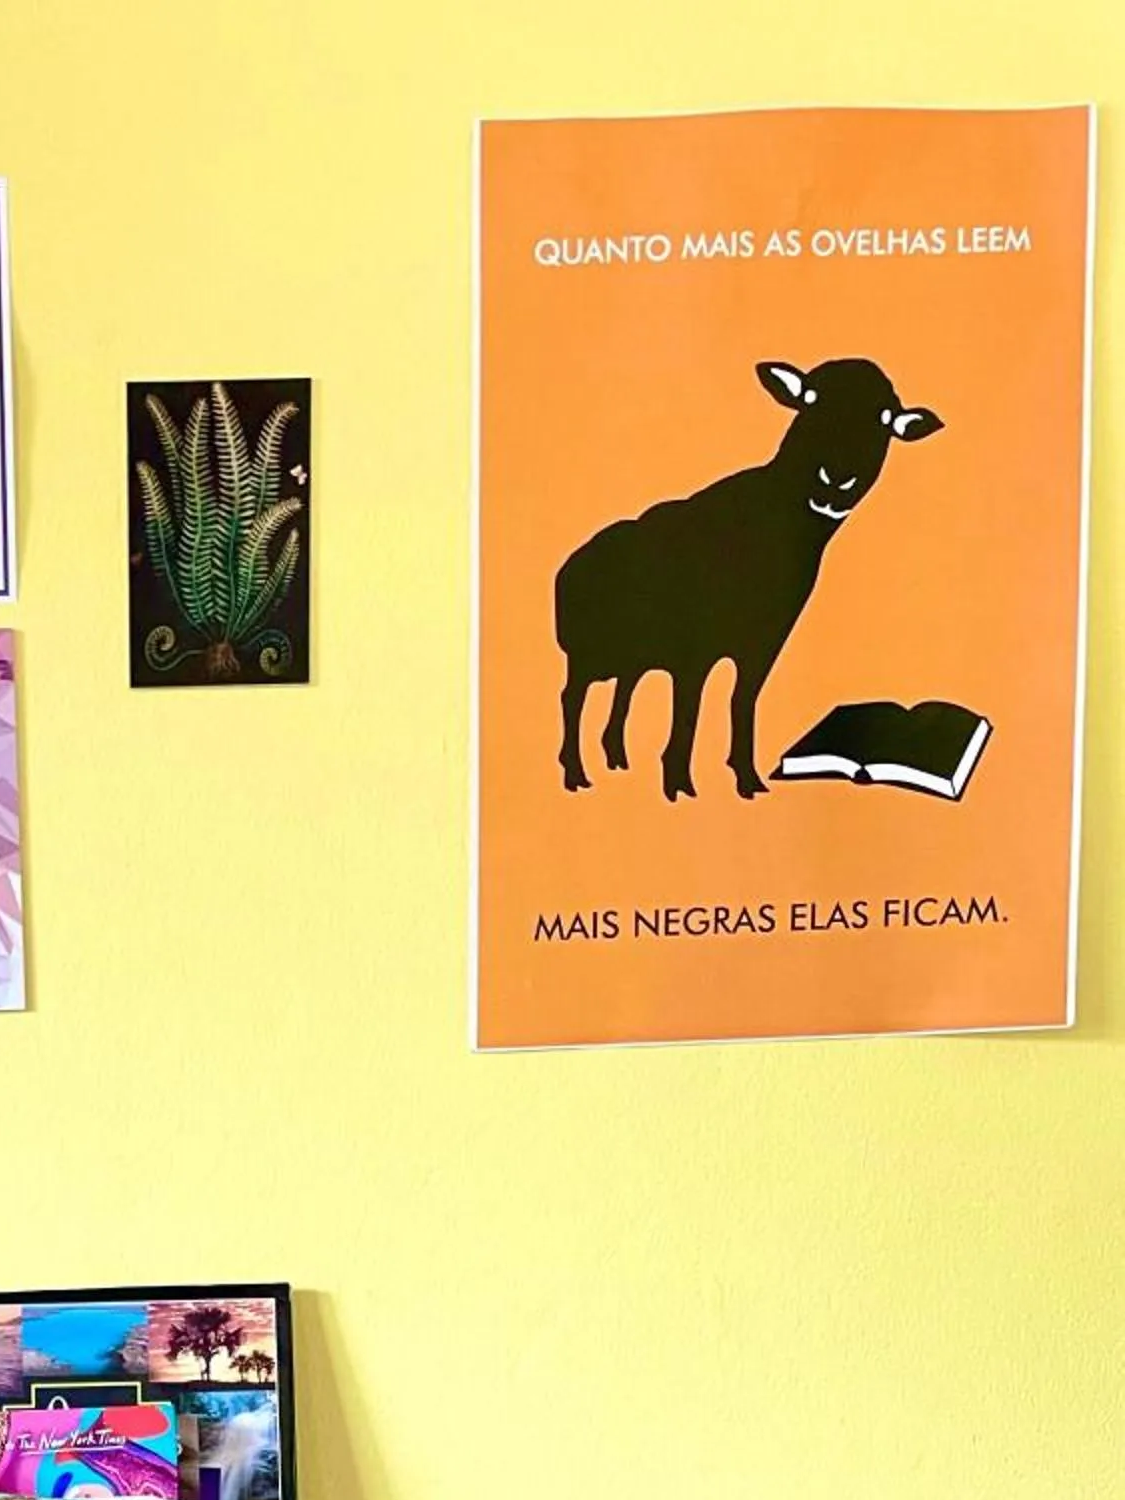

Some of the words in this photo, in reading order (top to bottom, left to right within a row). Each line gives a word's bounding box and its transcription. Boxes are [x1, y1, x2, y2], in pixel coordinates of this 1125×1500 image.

[534, 233, 671, 269] QUANTO
[681, 232, 754, 260] MAIS
[765, 231, 802, 258] AS
[810, 227, 946, 258] OVELHAS
[956, 227, 1031, 255] LEEM
[534, 911, 620, 943] MAIS
[632, 904, 776, 938] NEGRAS
[789, 900, 868, 931] ELAS
[883, 896, 1009, 929] FICAM.
[40, 1434, 66, 1450] New
[68, 1430, 98, 1447] York
